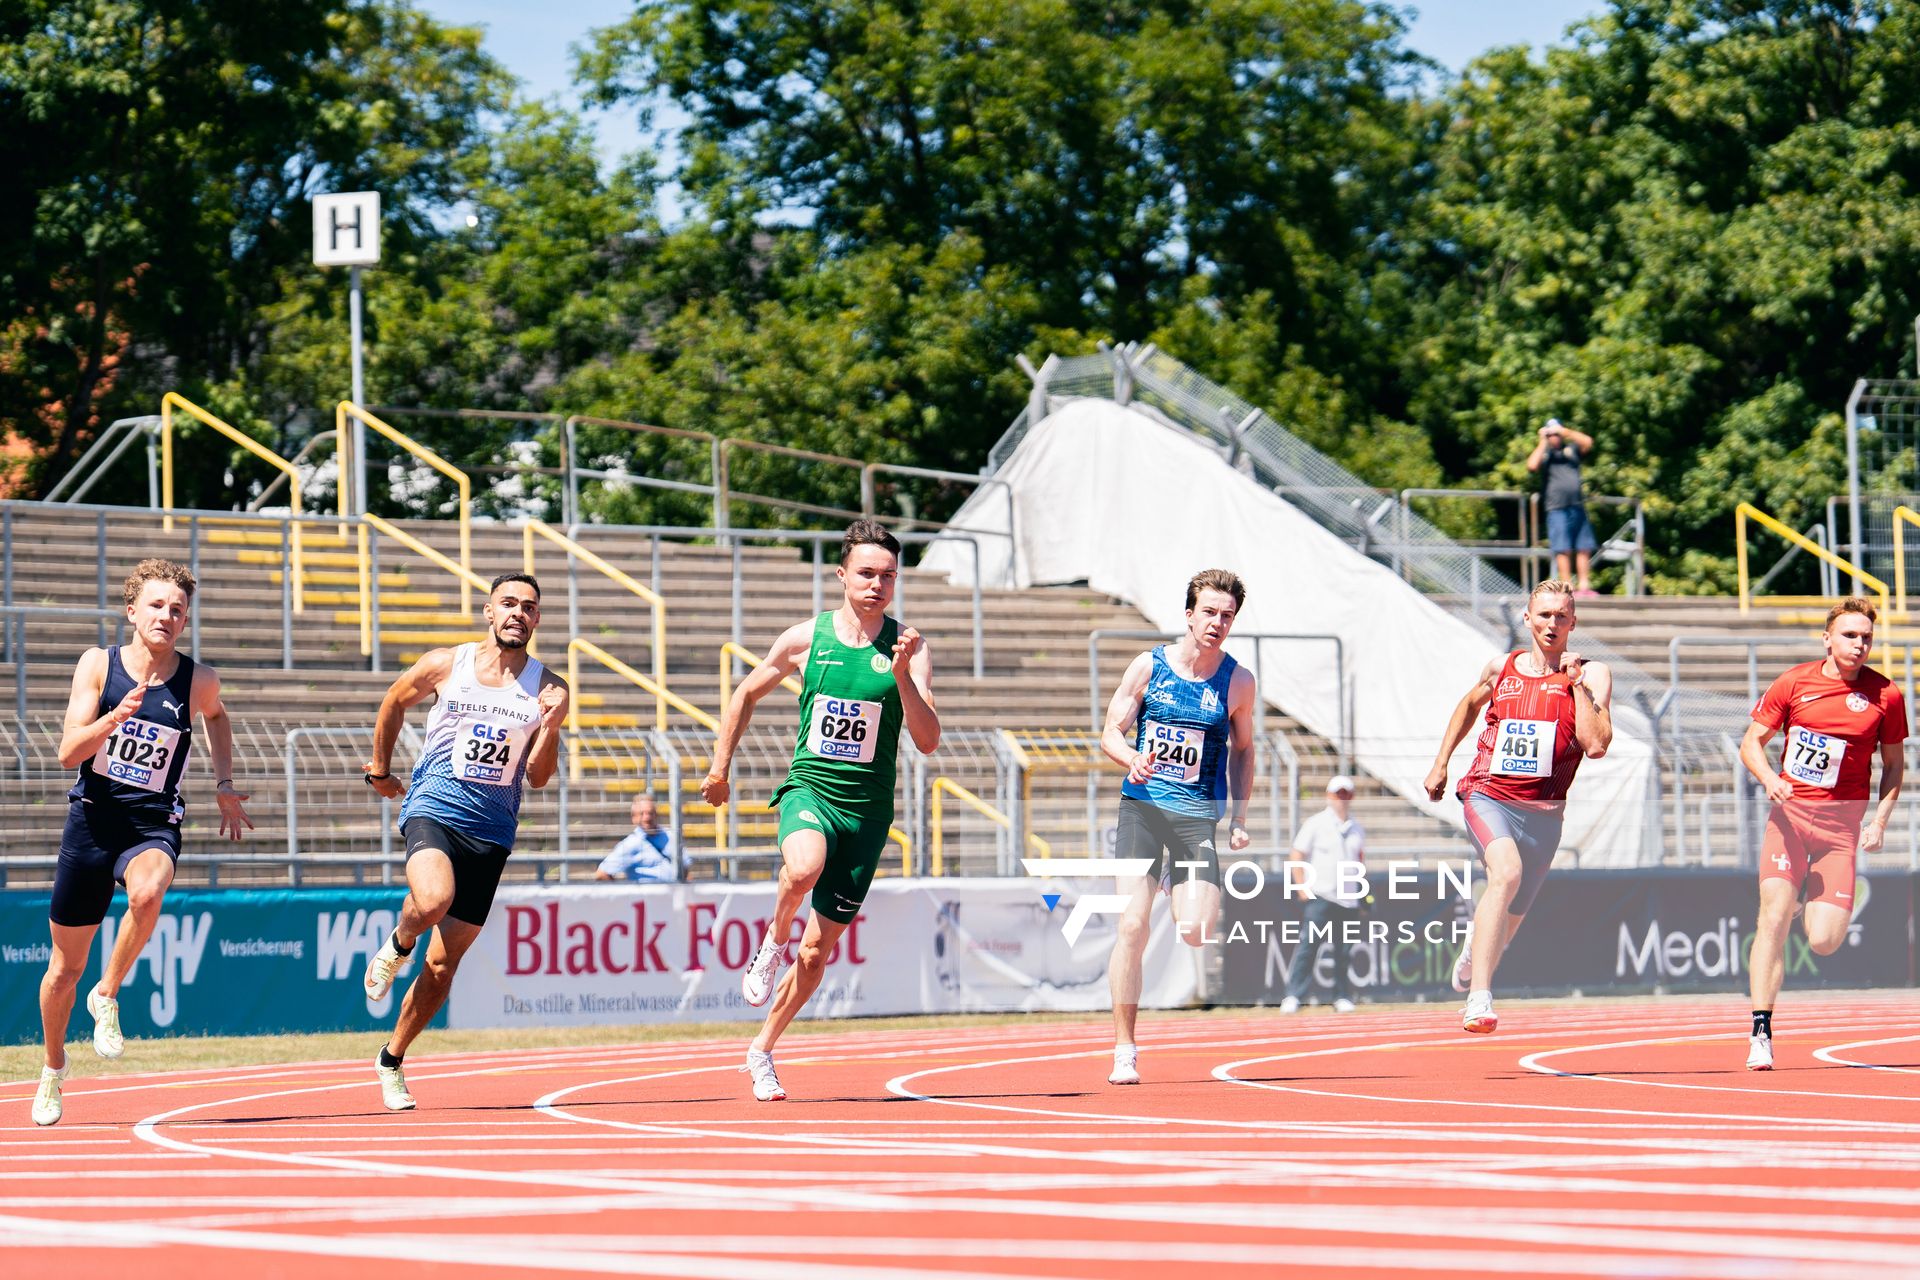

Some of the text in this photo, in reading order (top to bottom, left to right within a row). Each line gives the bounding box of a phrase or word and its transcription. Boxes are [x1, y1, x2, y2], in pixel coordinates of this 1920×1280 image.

[330, 205, 362, 250] H
[460, 703, 530, 723] TELIS FINANZ
[821, 715, 867, 743] 626
[106, 734, 169, 770] 1023
[464, 739, 511, 767] 324
[836, 745, 859, 754] PLAN
[1147, 738, 1198, 767] 1240
[1501, 736, 1539, 758] 461
[1794, 742, 1830, 770] 773
[125, 767, 150, 780] PLAN
[480, 768, 502, 778] PLAN
[1164, 765, 1184, 774] PLAN
[1516, 760, 1537, 769] PLAN
[219, 937, 304, 960] Versicherung
[505, 901, 867, 976] Black Foret
[503, 994, 532, 1014] Das
[535, 992, 573, 1014] stille
[578, 991, 690, 1012] Mineralwasse
[723, 988, 749, 1007] de
